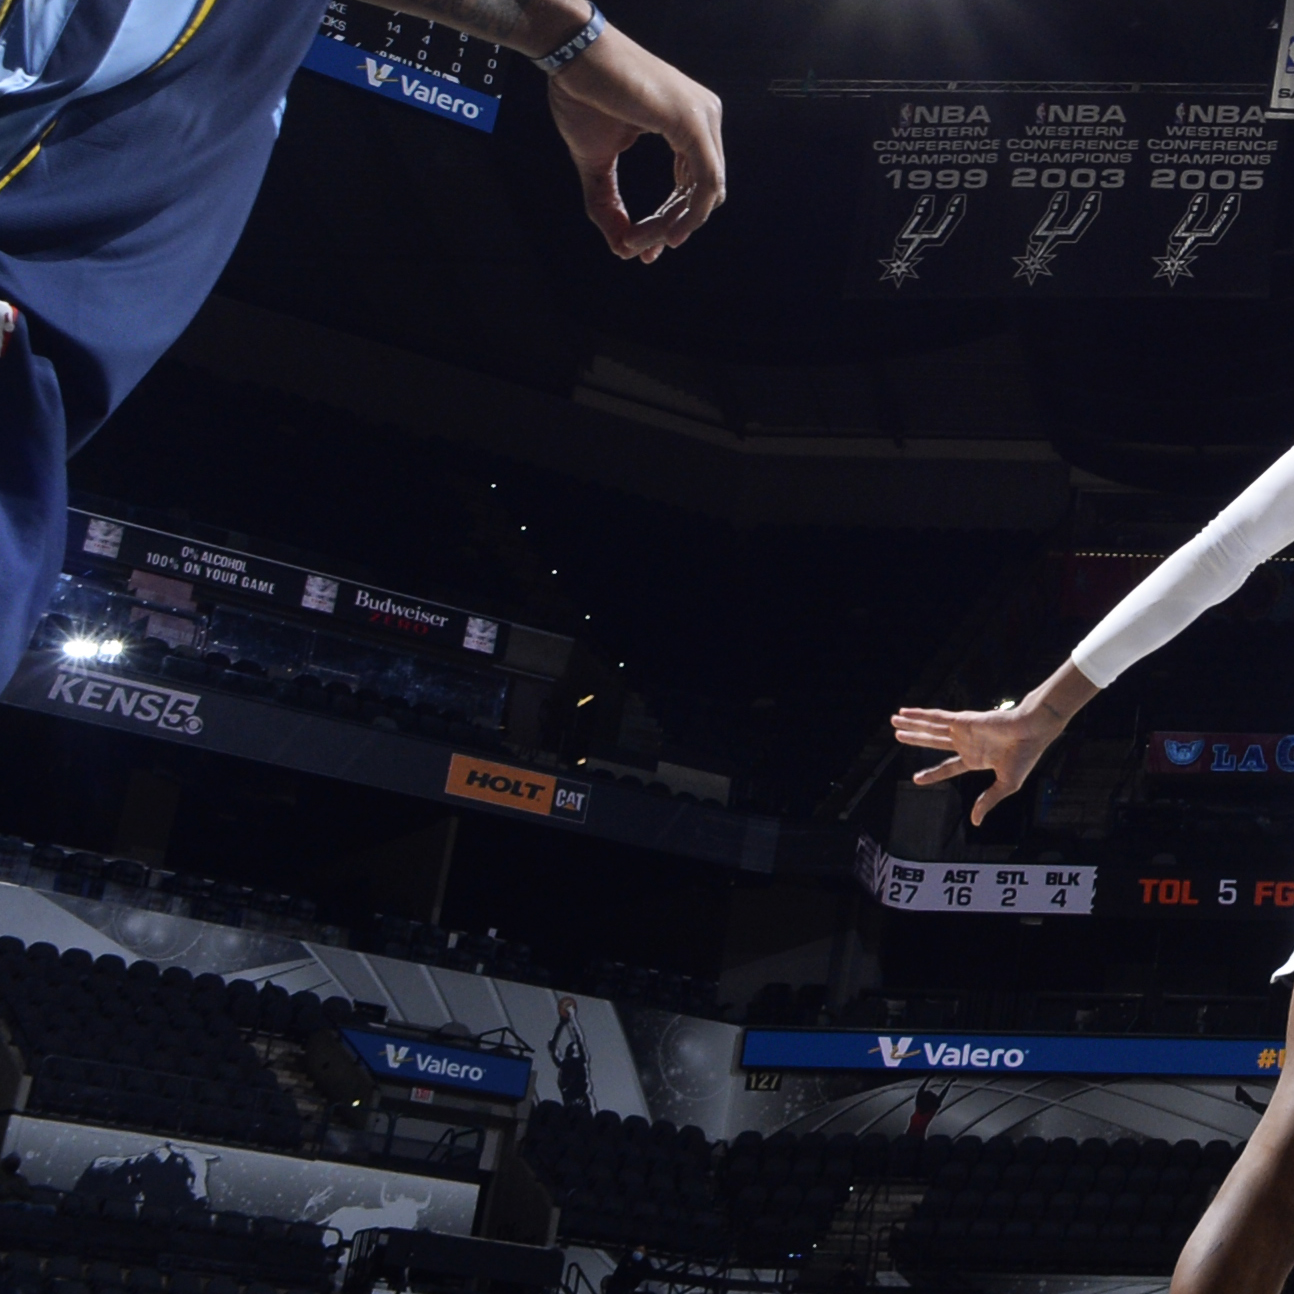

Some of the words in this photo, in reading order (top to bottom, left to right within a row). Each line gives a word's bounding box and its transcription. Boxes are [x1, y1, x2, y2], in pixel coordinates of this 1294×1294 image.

[400, 74, 481, 121] Valero
[914, 105, 991, 123] NBA
[1049, 105, 1127, 123] NBA
[1189, 105, 1266, 124] NBA
[892, 127, 988, 137] WESTERN
[1025, 126, 1123, 136] WESTERN
[1165, 126, 1263, 137] WESTERN
[873, 139, 1000, 151] CONFERENCE
[1006, 139, 1139, 151] CONFERENCE
[1147, 139, 1278, 151] CONFERENCE
[879, 153, 998, 165] CHAMPIONS
[1009, 152, 1132, 164] CHAMPIONS
[1150, 153, 1271, 166] CHAMPIONS
[885, 169, 989, 189] 1999
[1011, 168, 1126, 188] 2003
[1150, 169, 1265, 190] 2005
[181, 545, 199, 561] 0%
[201, 549, 248, 573] ALCOHOL
[145, 551, 180, 572] 100%
[183, 559, 201, 577] ON
[205, 564, 238, 587] YOUR
[241, 572, 276, 595] GAME
[354, 589, 449, 630] Budweiser
[1211, 744, 1268, 772] LA
[465, 768, 545, 801] HOLT
[555, 787, 585, 811] CAT
[891, 865, 925, 884] REB
[943, 868, 979, 885] AST
[996, 870, 1029, 886] STL
[1045, 871, 1080, 887] BLK
[888, 884, 919, 905] 27
[943, 887, 972, 906] 16
[1001, 887, 1018, 907] 2
[1050, 888, 1068, 908] 4
[1138, 879, 1199, 905] TOL
[1218, 880, 1238, 905] 5
[923, 1041, 1026, 1068] Valero
[415, 1053, 484, 1082] Valero
[747, 1072, 781, 1090] 127
